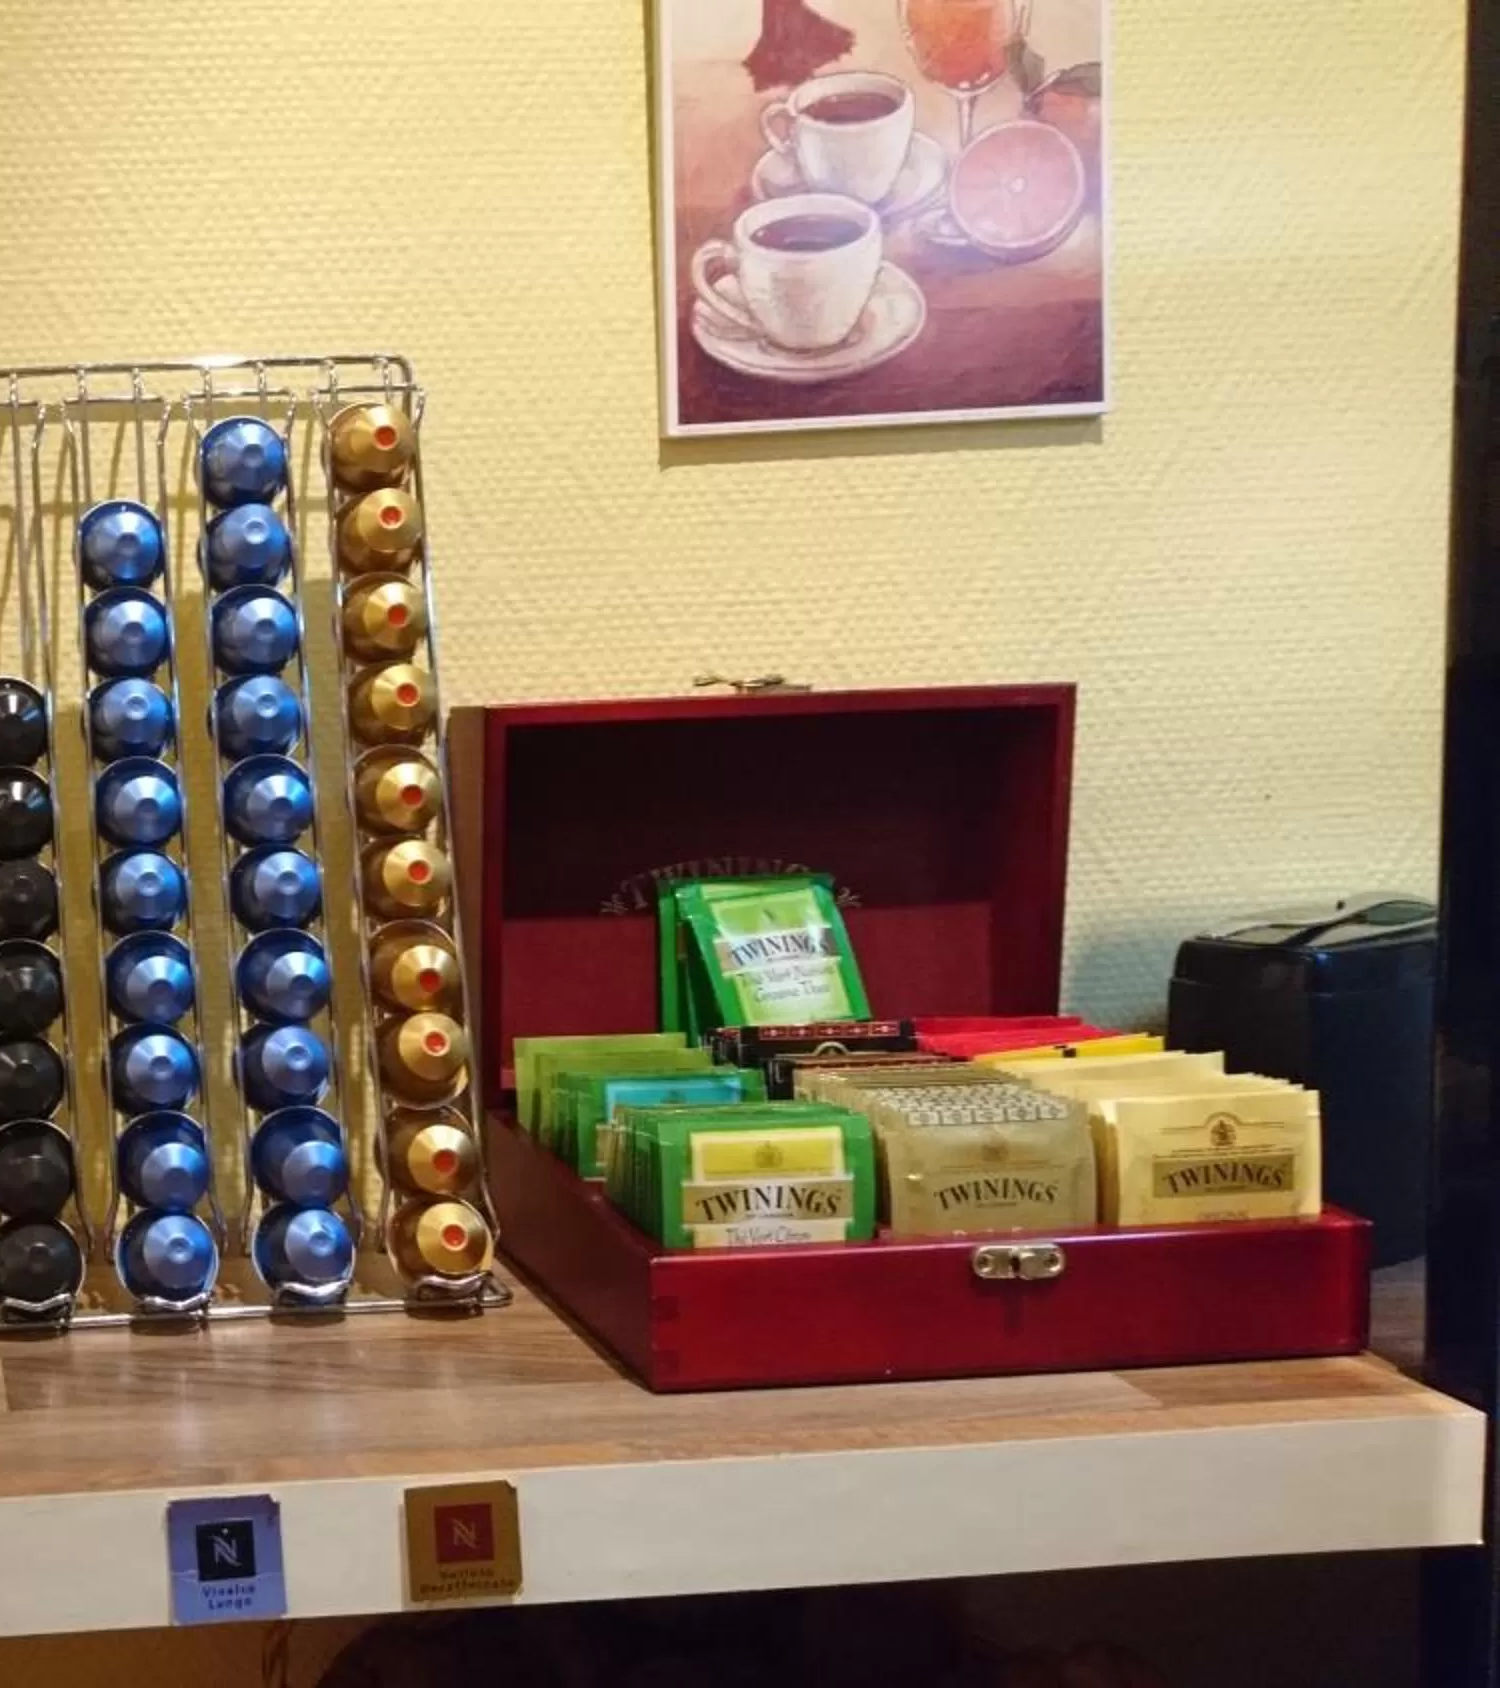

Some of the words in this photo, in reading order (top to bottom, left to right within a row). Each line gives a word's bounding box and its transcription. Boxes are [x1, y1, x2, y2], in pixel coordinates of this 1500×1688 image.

[933, 1177, 1058, 1210] TWININGS
[1162, 1162, 1285, 1194] TWININGS
[695, 1185, 841, 1221] TWININGS
